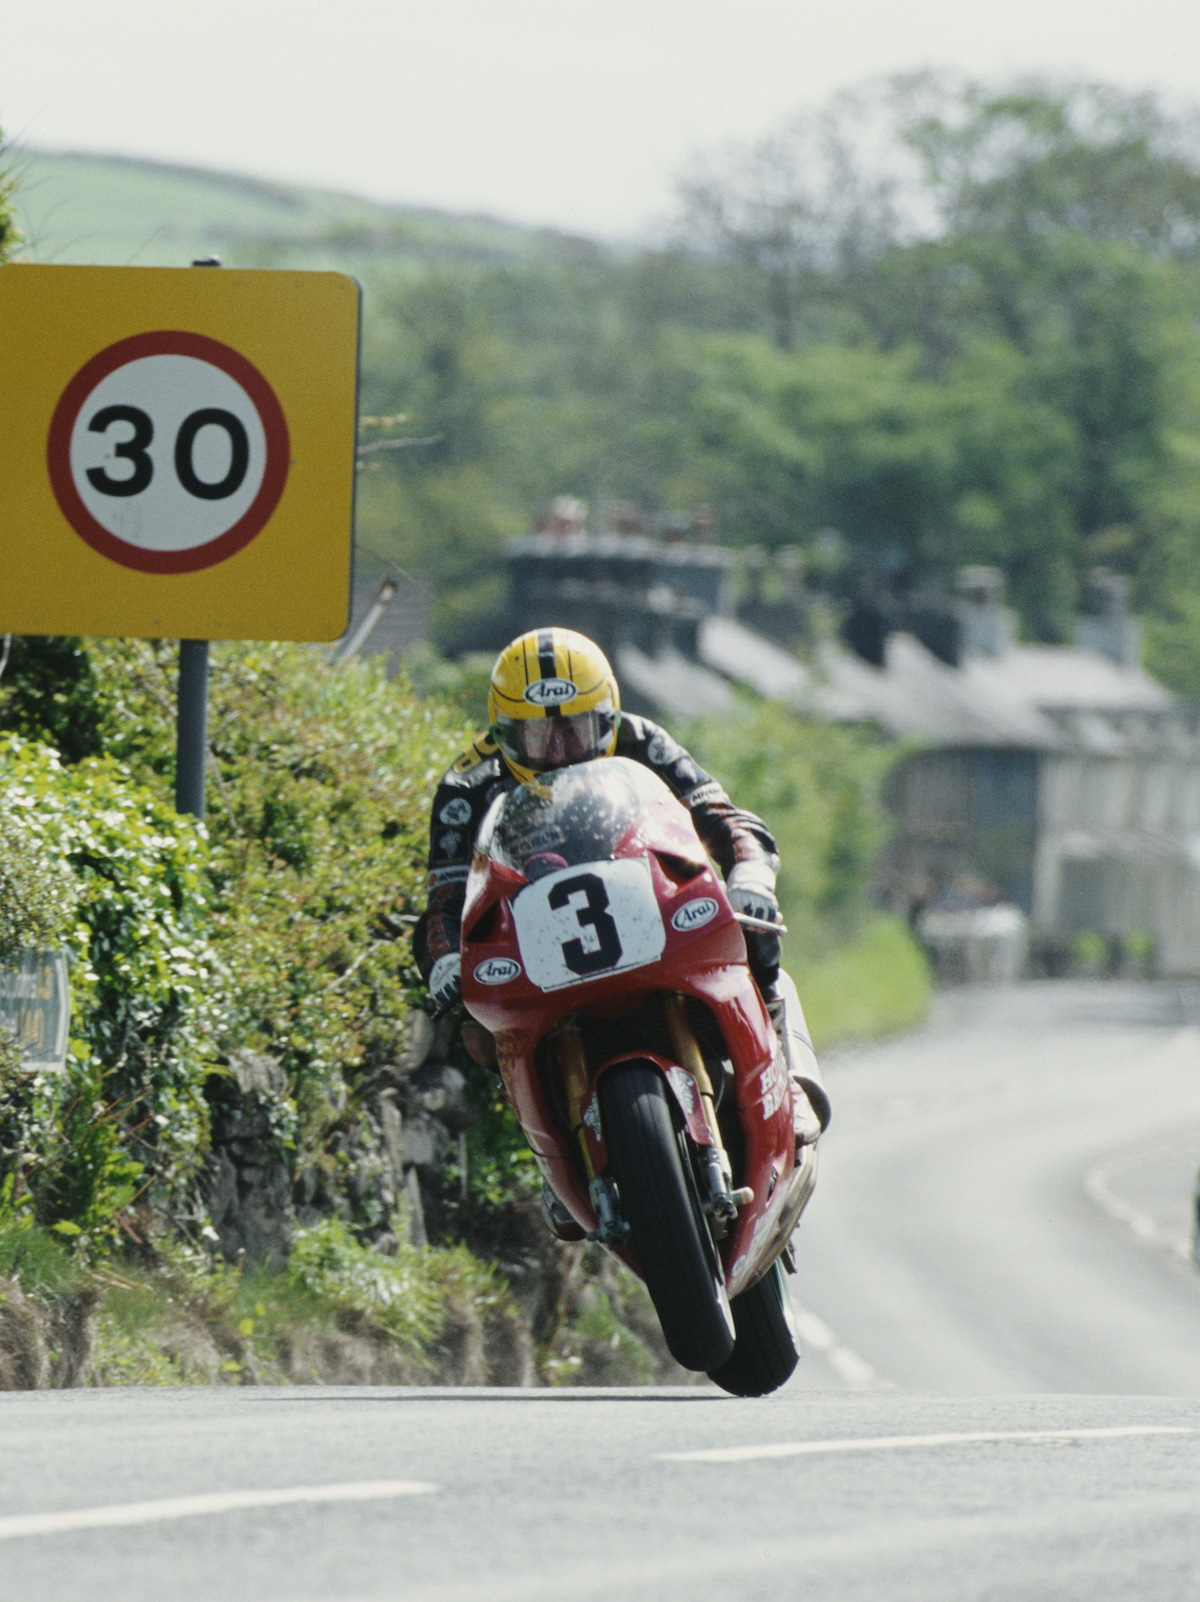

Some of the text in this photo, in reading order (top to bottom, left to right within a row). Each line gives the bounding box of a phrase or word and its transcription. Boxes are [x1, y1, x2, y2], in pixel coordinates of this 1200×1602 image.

[86, 404, 250, 501] 30
[525, 682, 570, 703] Arai
[548, 873, 624, 976] 3
[674, 900, 712, 928] Arai
[475, 961, 513, 982] Arai
